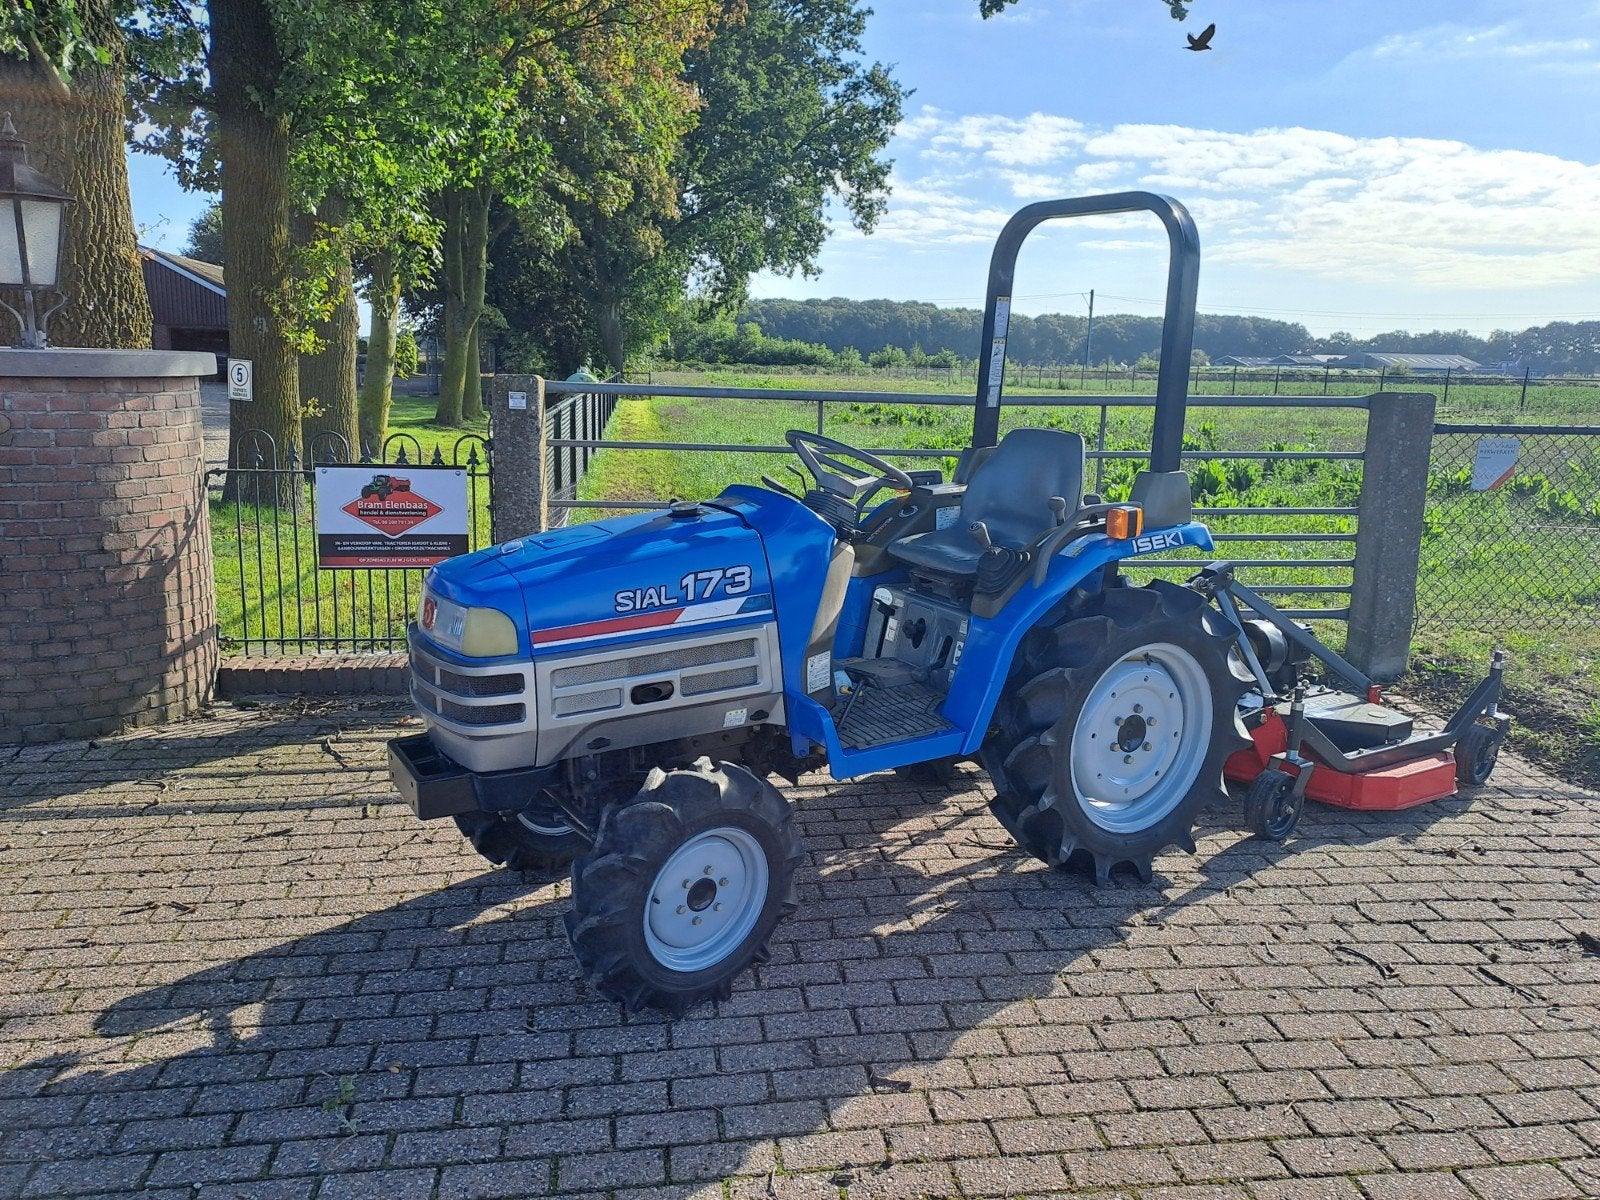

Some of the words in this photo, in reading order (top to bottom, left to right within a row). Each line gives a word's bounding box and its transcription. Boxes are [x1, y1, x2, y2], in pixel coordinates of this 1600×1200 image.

[237, 367, 243, 382] 5
[357, 500, 383, 509] Bram
[385, 500, 428, 509] Elenbaas
[1131, 531, 1185, 554] ISEKI
[615, 585, 678, 613] SIAL
[680, 565, 752, 602] 173
